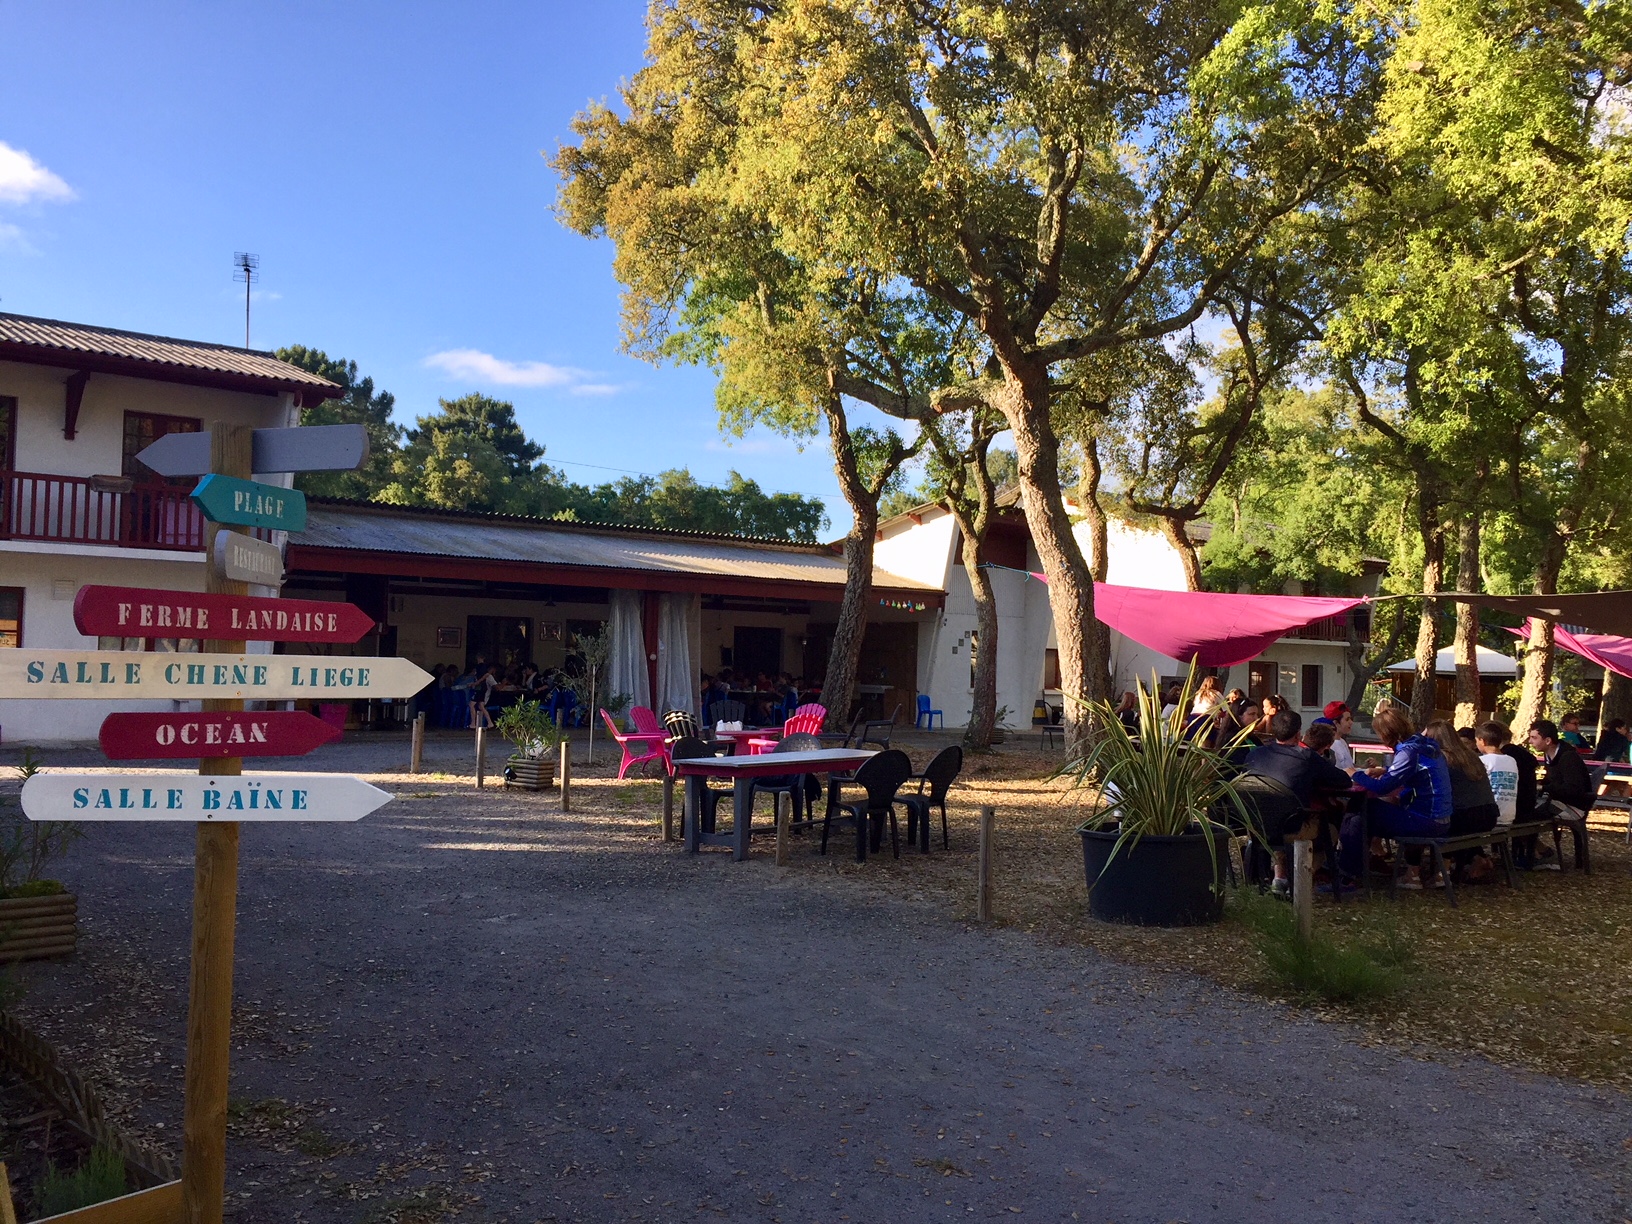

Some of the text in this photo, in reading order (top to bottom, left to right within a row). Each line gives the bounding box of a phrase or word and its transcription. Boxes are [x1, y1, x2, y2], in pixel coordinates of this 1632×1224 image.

[234, 490, 284, 518] PLAGE
[118, 602, 338, 633] FERME LANDAISE
[27, 661, 371, 687] SALLE CHENE LIEGE
[155, 722, 269, 746] OCEAN
[73, 781, 309, 811] SALLE BAÏNE
